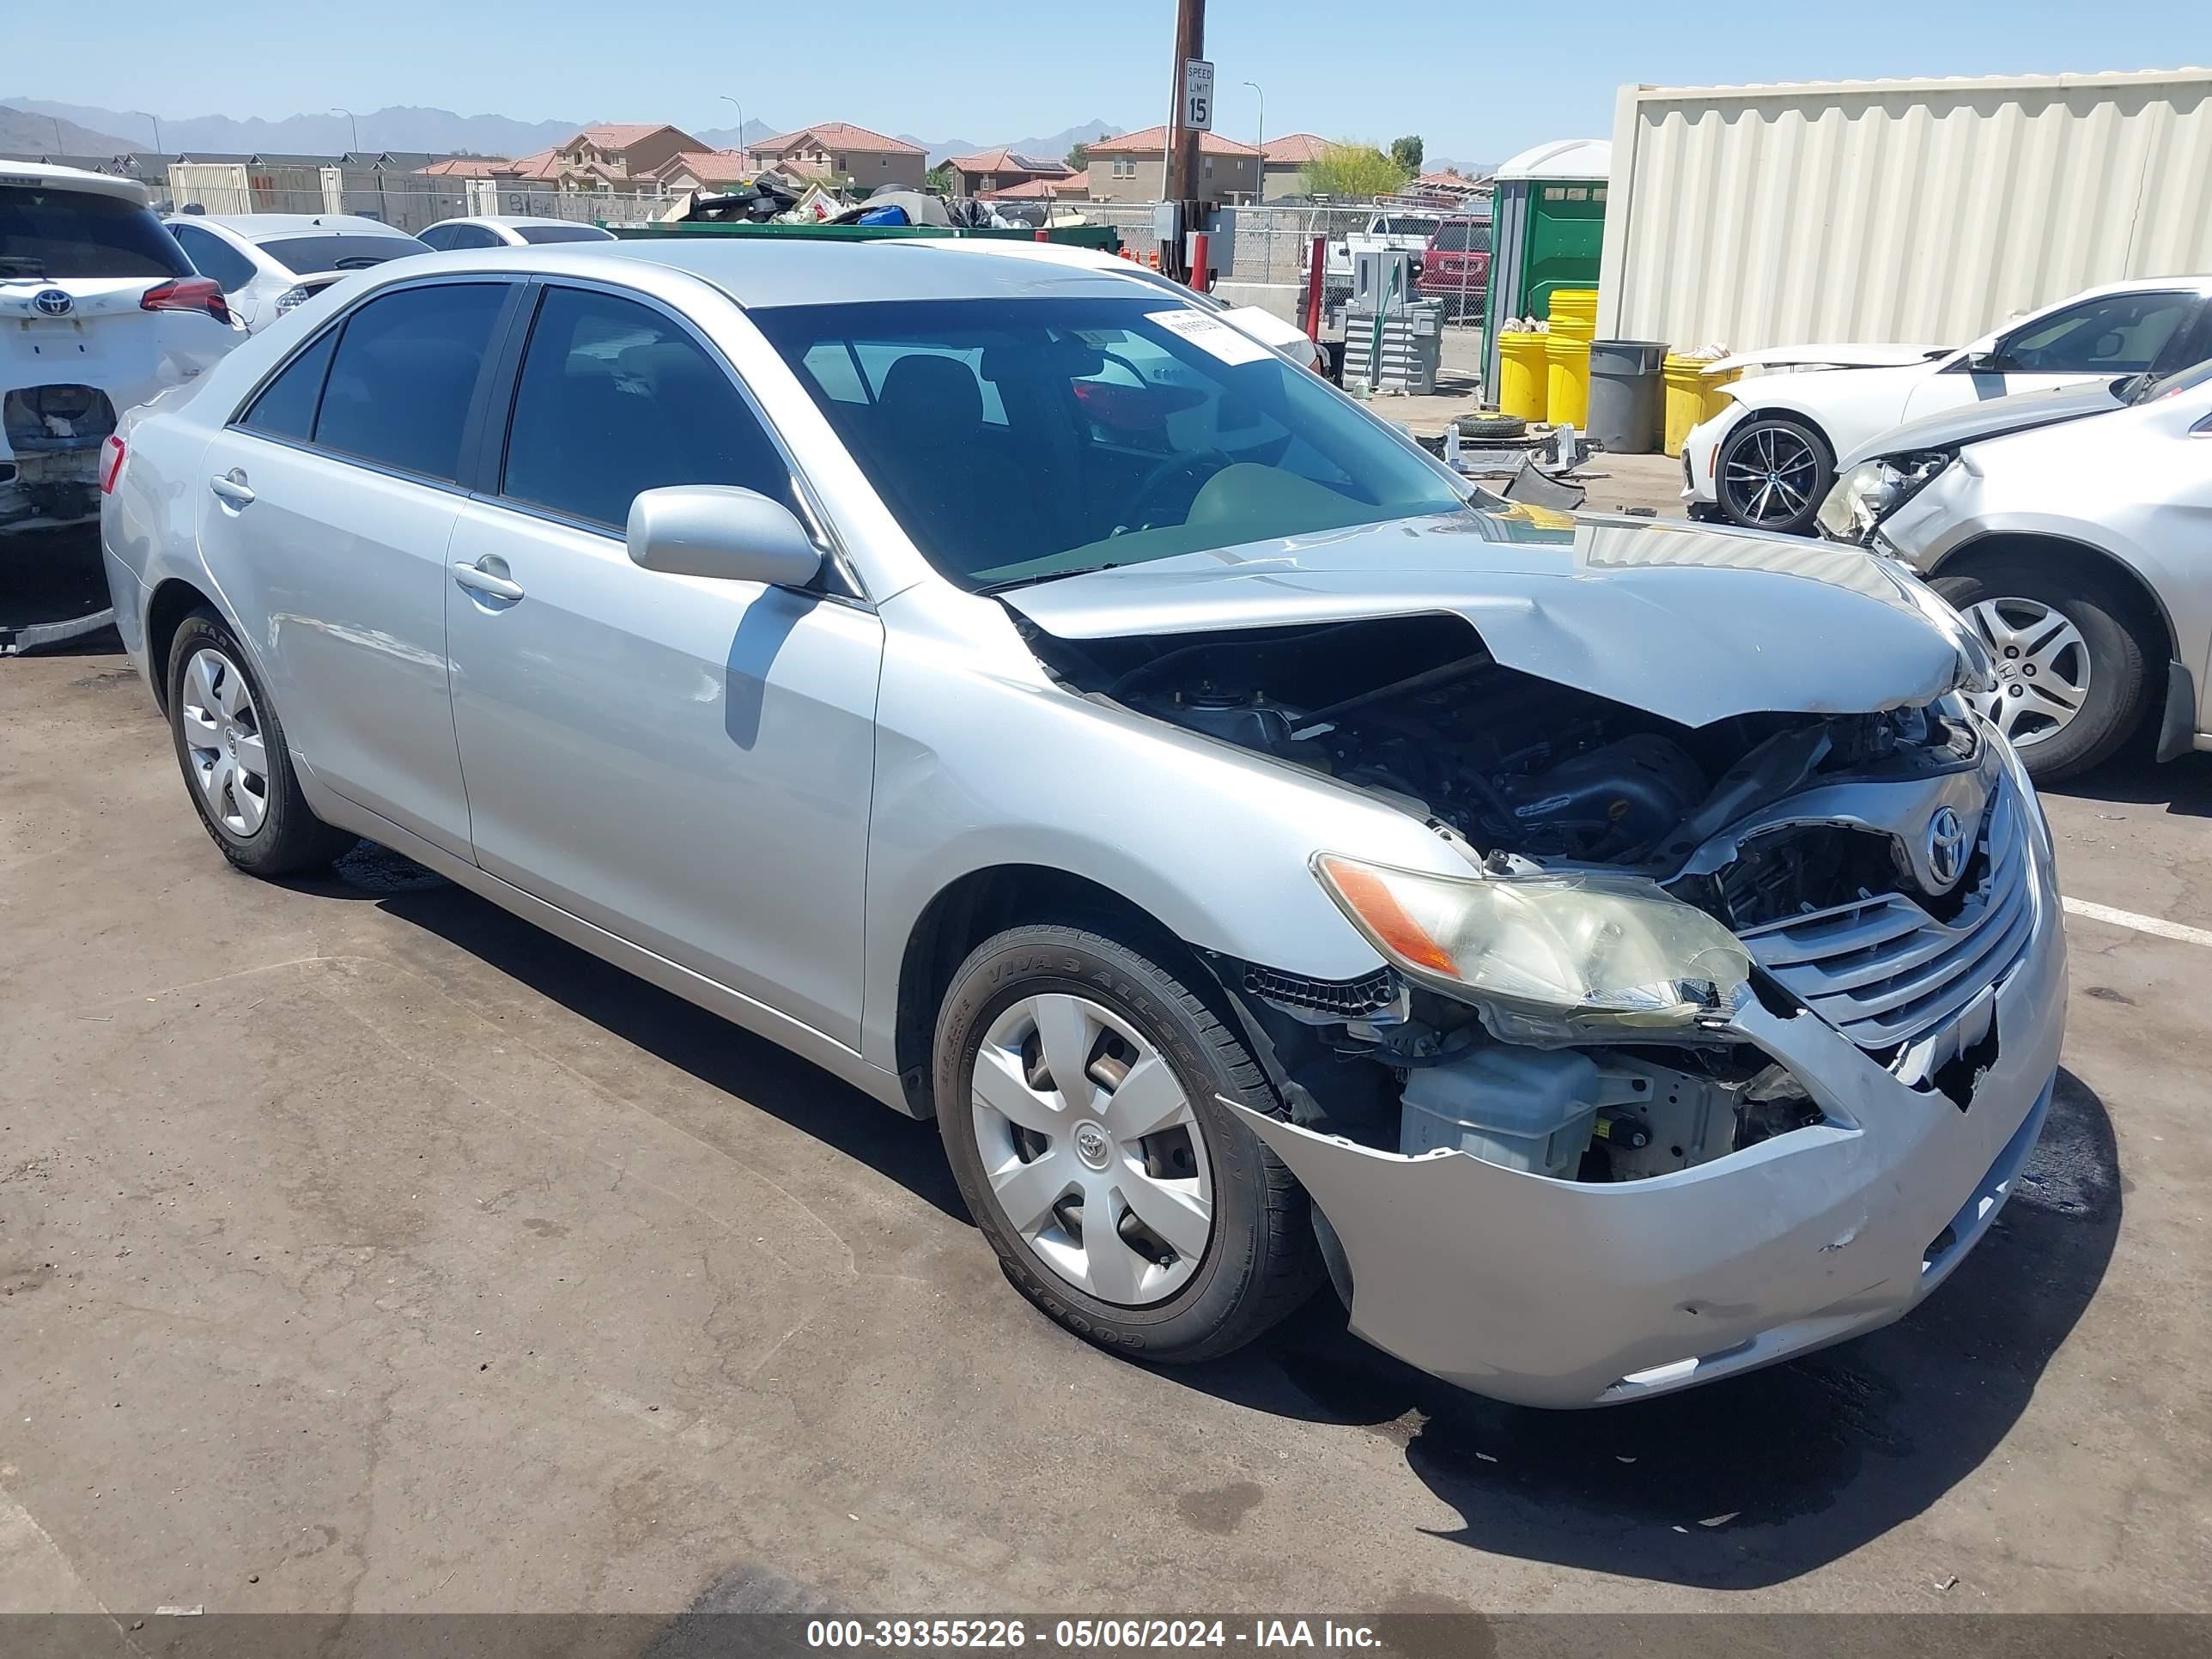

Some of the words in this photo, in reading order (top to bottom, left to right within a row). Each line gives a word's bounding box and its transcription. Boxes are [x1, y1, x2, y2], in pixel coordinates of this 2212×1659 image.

[1188, 67, 1212, 80] SPEED
[1189, 82, 1209, 94] LIMIT
[1189, 97, 1206, 123] 15
[988, 954, 1053, 983] VIVA
[1061, 957, 1080, 973] 3
